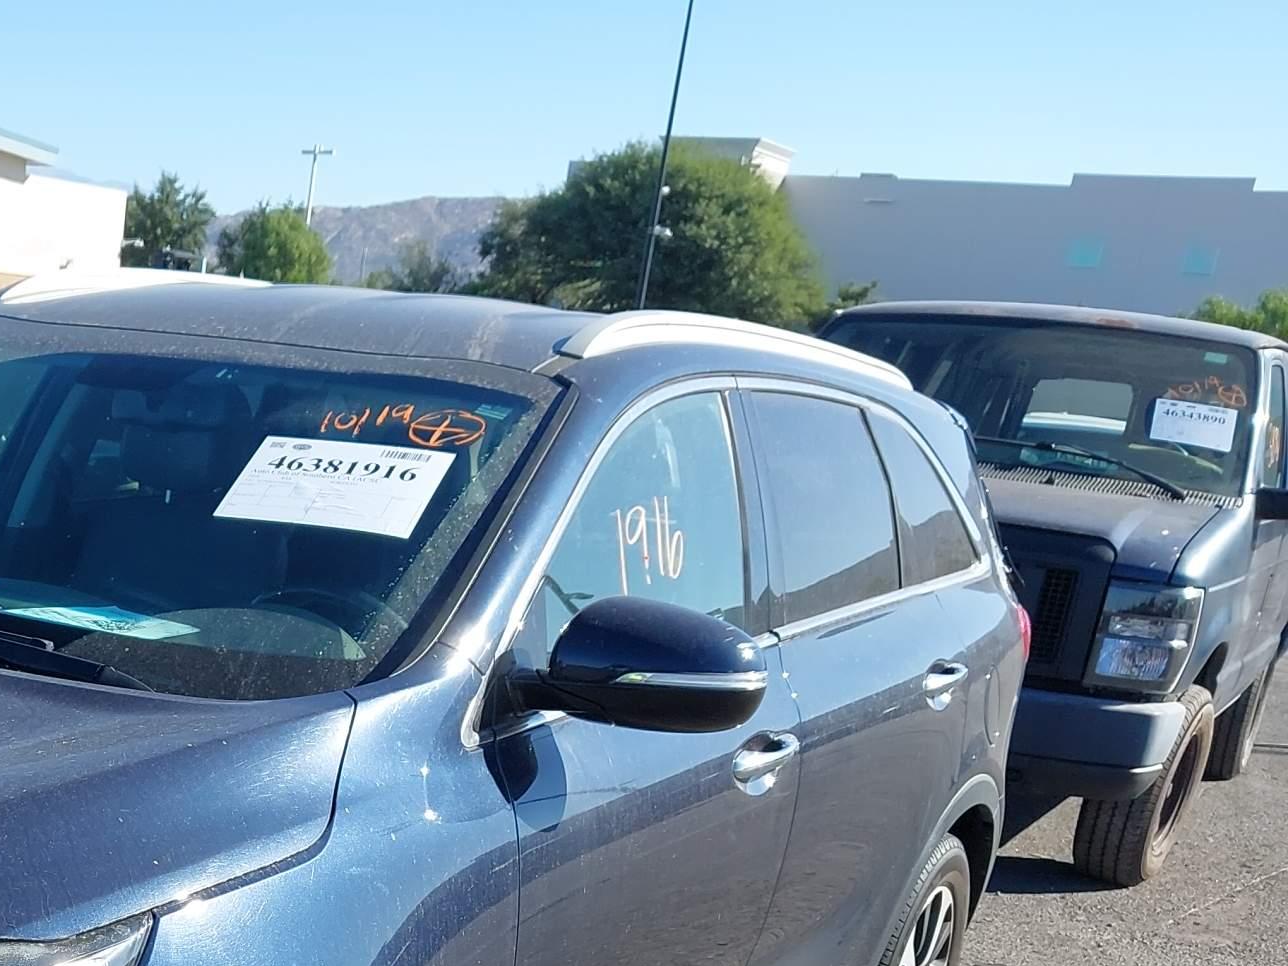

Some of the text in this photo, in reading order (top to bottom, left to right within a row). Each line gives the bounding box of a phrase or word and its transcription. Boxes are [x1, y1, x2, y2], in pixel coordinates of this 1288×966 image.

[320, 403, 415, 438] 10/19
[1162, 408, 1226, 425] 46343890
[267, 454, 421, 482] 46381916
[609, 495, 684, 597] 1916
